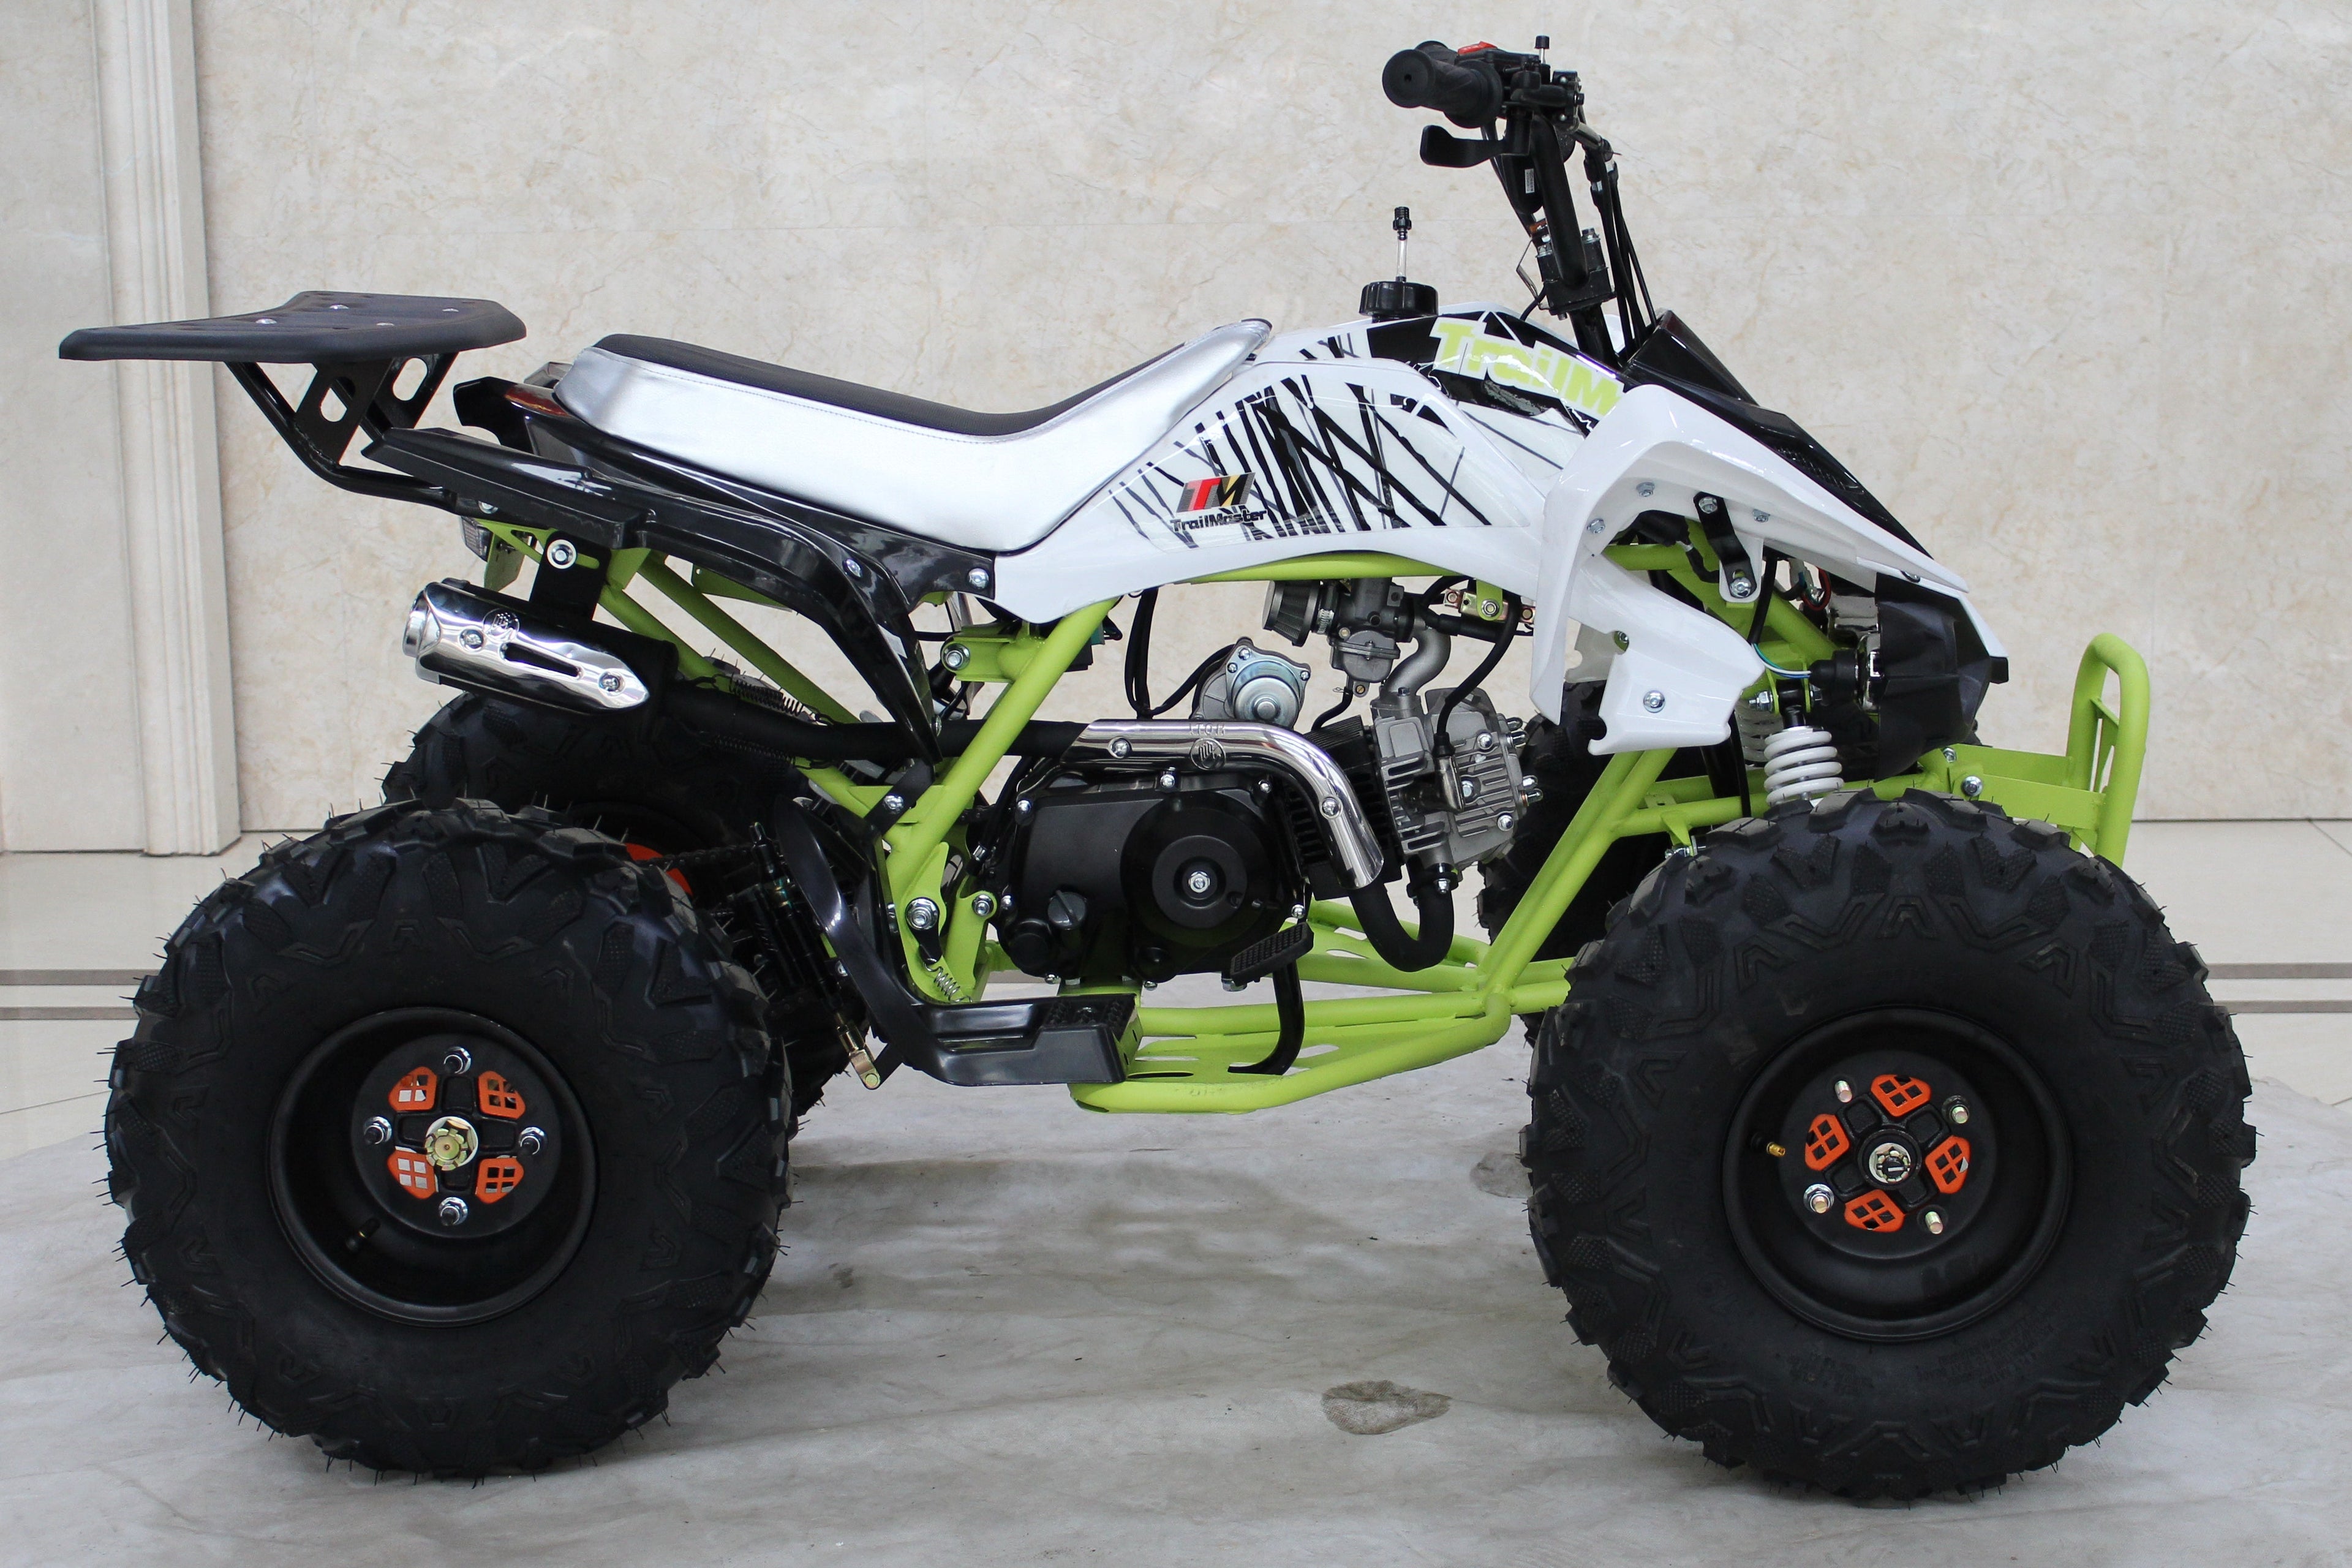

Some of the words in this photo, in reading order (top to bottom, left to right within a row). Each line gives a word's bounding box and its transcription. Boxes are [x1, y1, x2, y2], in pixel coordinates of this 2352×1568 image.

[1437, 322, 1621, 417] TrailM
[1177, 472, 1255, 513] TM
[1170, 509, 1267, 532] TrailMaster
